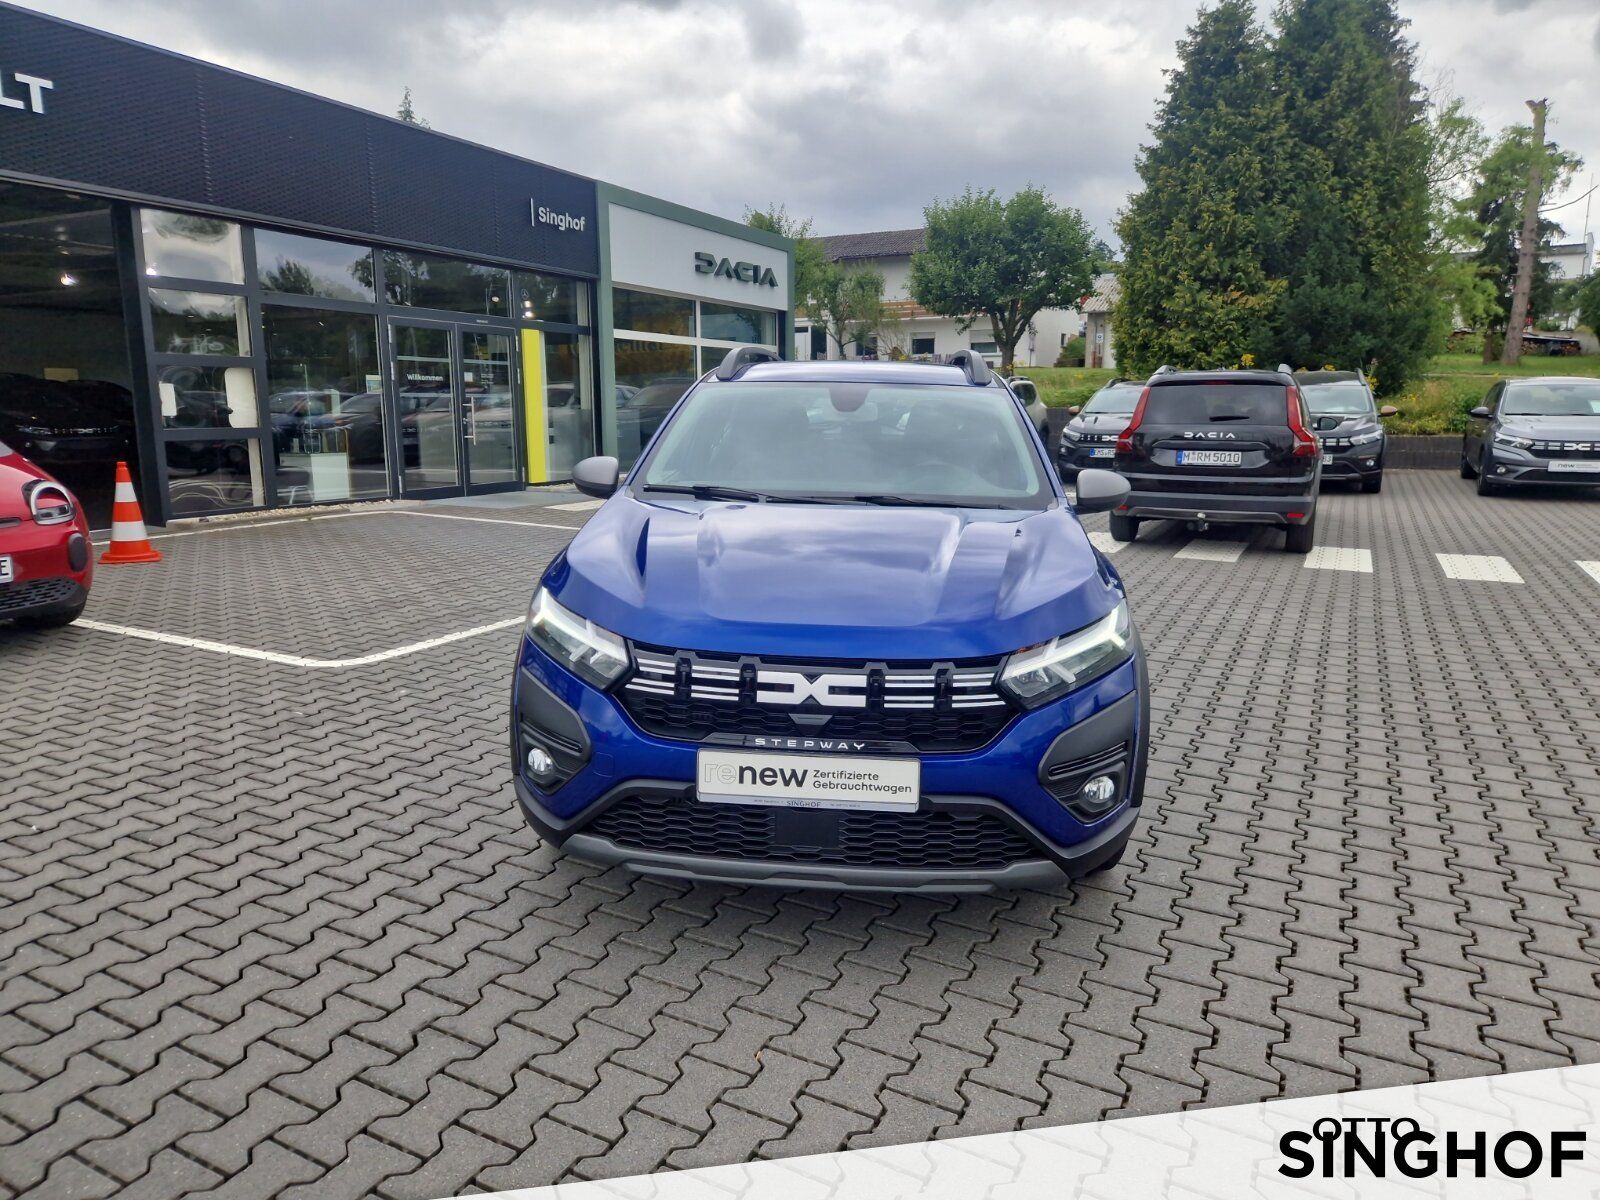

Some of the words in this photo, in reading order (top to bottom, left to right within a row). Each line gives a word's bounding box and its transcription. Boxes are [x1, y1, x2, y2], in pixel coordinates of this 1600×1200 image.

[538, 206, 586, 231] Singhof
[694, 252, 779, 287] DACIA
[406, 373, 444, 382] Willkommen
[1183, 431, 1236, 439] DACIA
[755, 738, 865, 750] STEPWAY
[704, 763, 809, 788] renew
[812, 769, 880, 781] Zertifizierte
[812, 780, 913, 795] Gebrauchtwagen
[786, 800, 822, 808] SINGHOF
